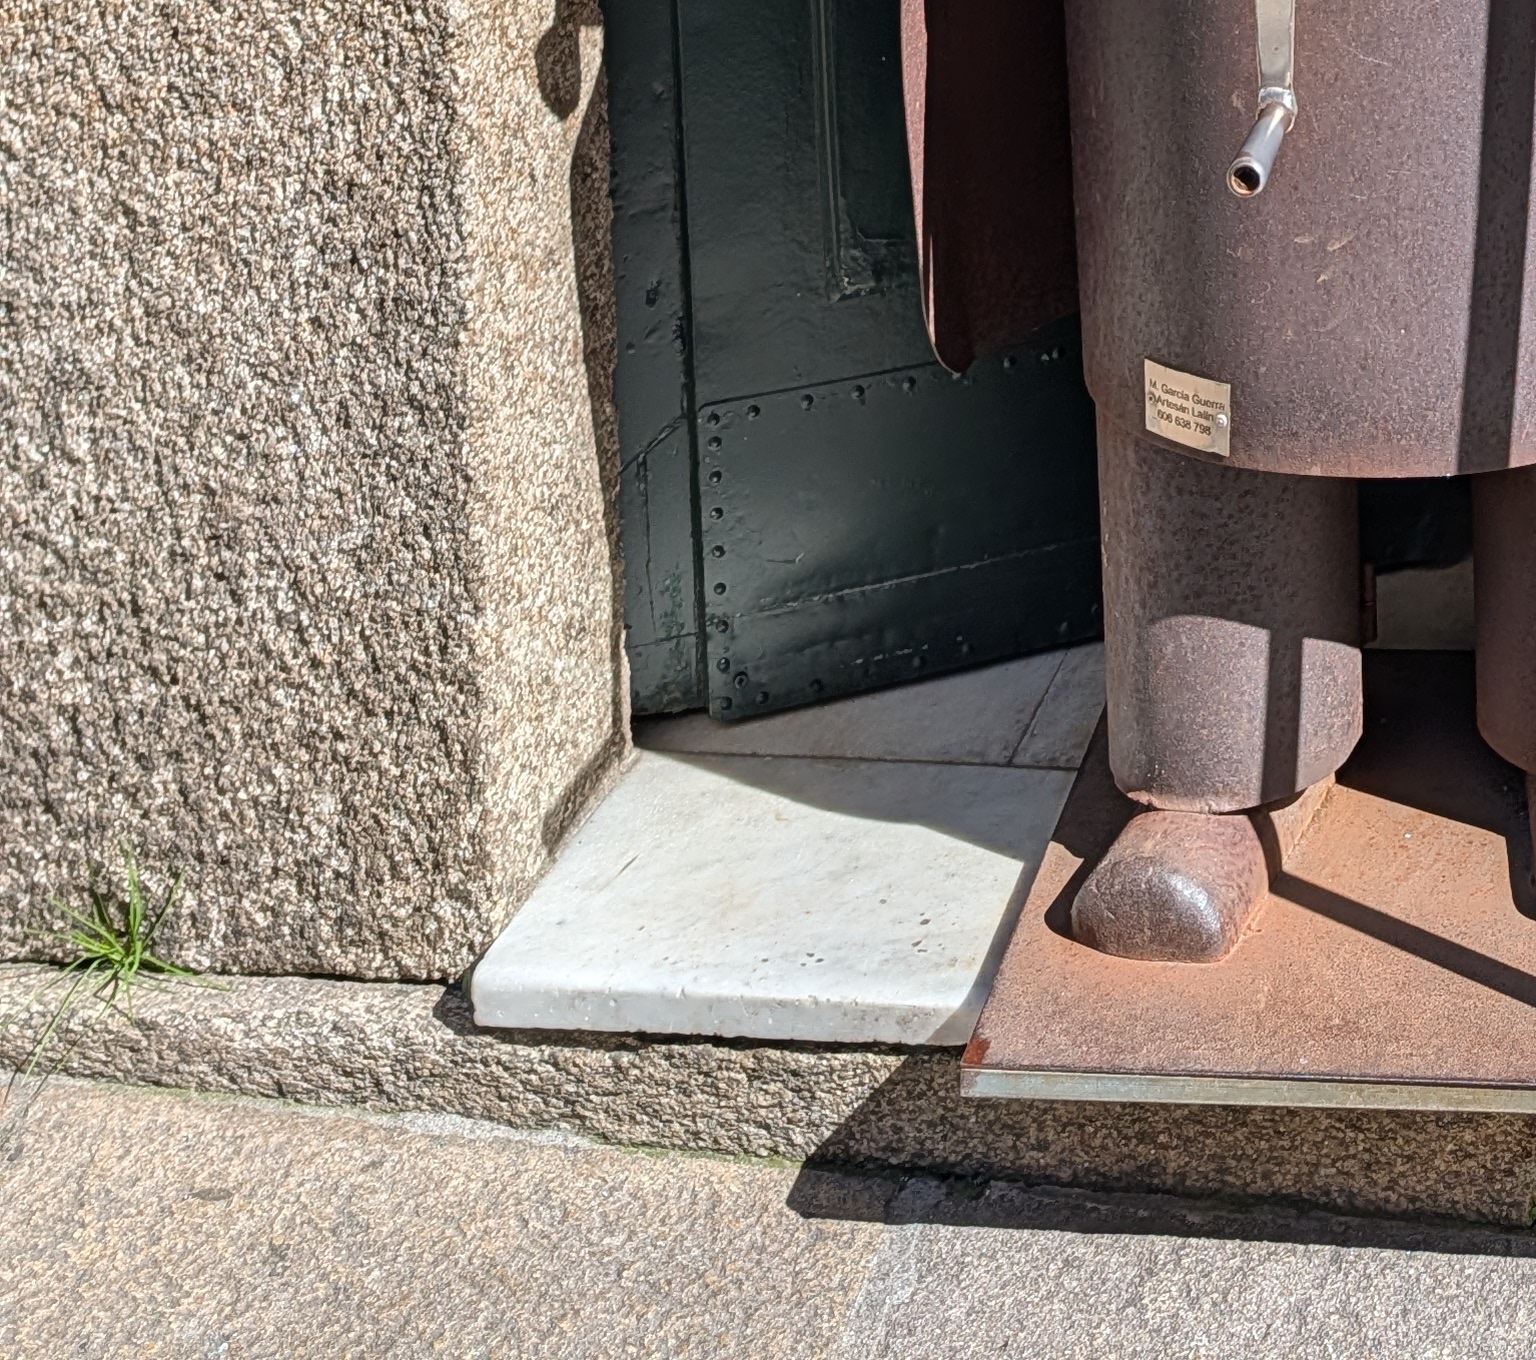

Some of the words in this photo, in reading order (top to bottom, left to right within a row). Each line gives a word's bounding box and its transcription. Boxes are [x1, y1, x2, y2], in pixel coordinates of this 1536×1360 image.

[1149, 378, 1159, 391] M.
[1191, 393, 1226, 411] Guerra
[1174, 415, 1192, 430] 638
[1193, 422, 1212, 436] 798
